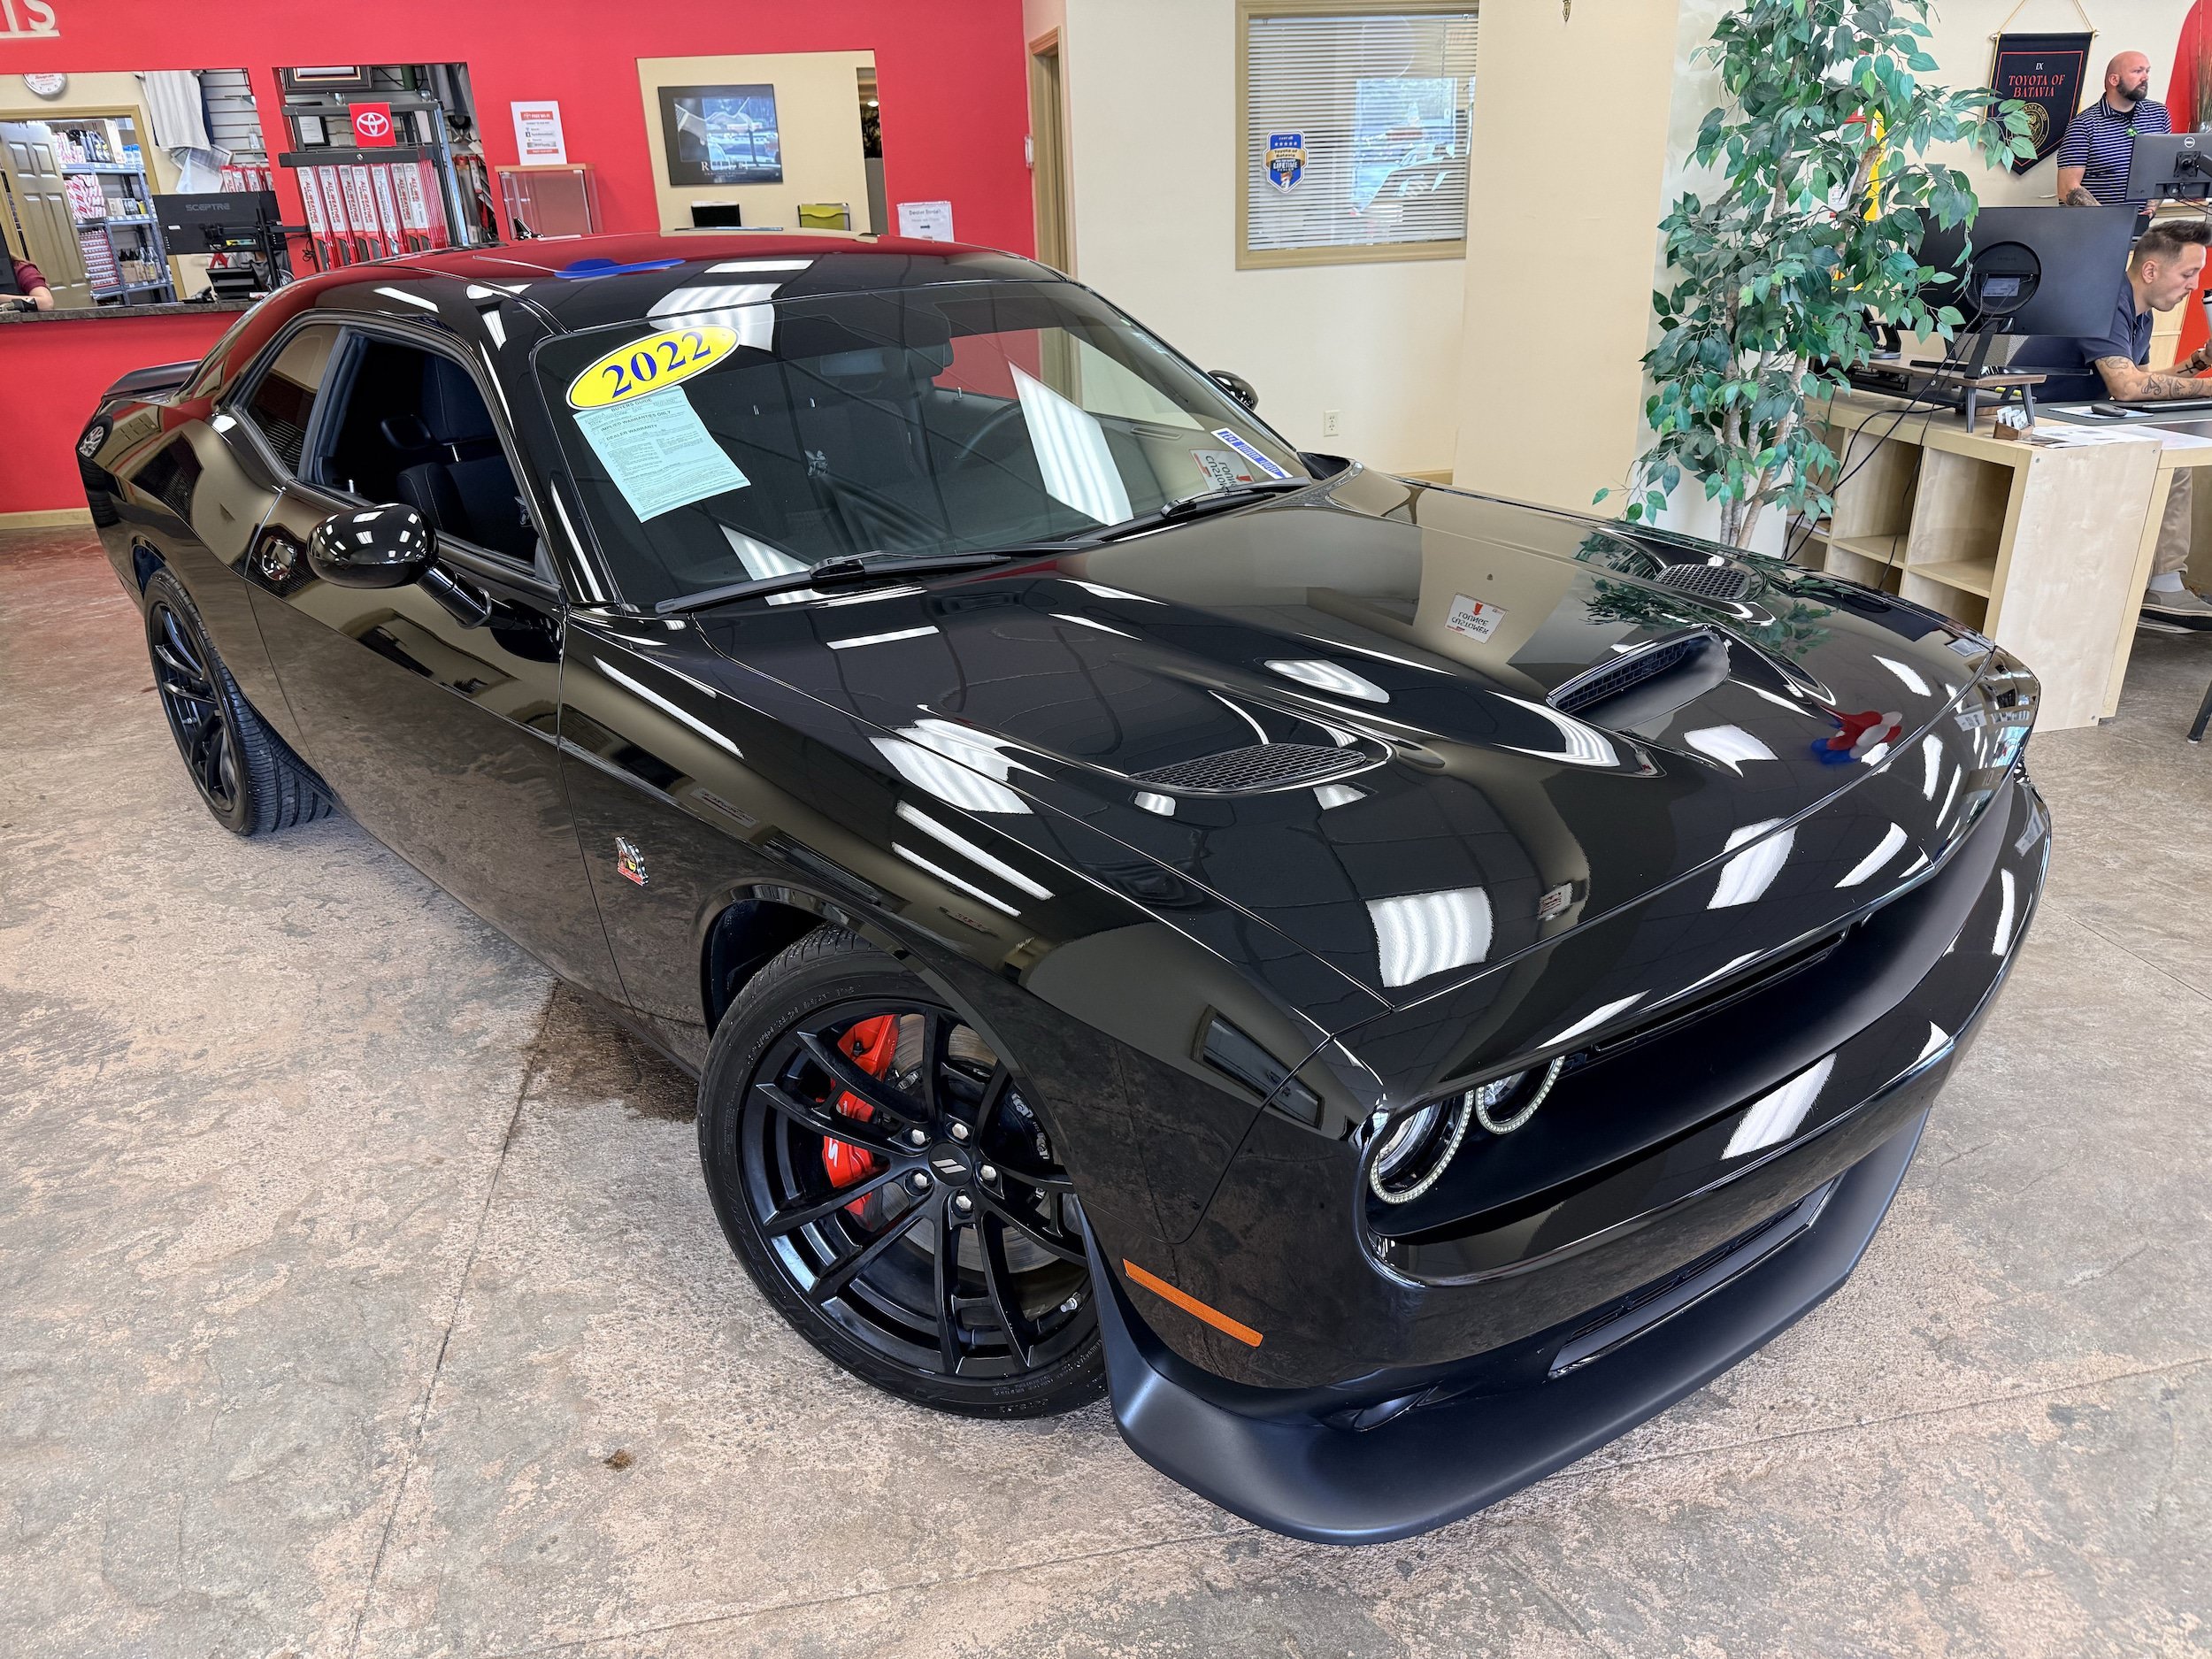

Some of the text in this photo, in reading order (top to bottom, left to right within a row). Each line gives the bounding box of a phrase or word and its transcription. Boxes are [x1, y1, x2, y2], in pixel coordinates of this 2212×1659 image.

[2035, 62, 2044, 71] IX
[2008, 74, 2065, 86] TOYOTA OF
[2013, 87, 2055, 97] BATAVIA
[185, 203, 230, 211] SCEPTRE
[603, 331, 711, 398] 2022
[611, 403, 634, 411] BUYERS
[601, 421, 622, 432] IMPLIED
[622, 413, 657, 425] WARRANTIES
[606, 425, 657, 441] DEALER WARRANTY
